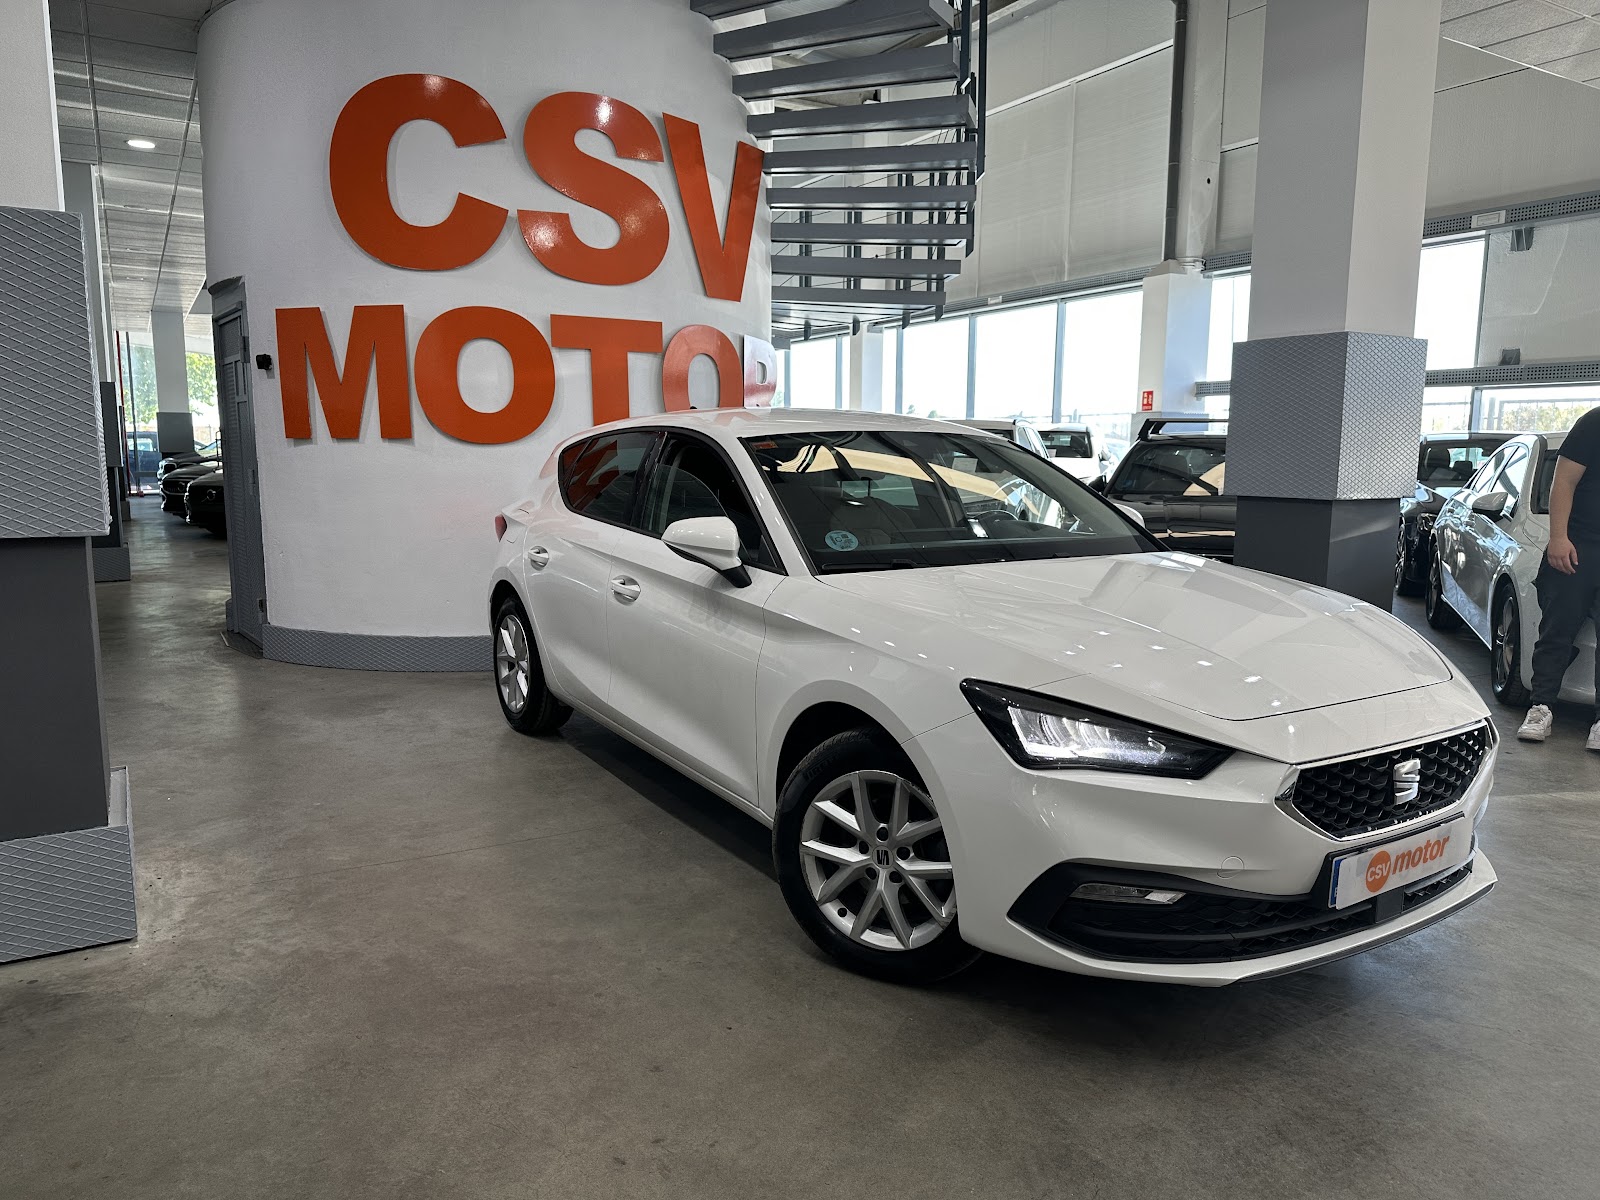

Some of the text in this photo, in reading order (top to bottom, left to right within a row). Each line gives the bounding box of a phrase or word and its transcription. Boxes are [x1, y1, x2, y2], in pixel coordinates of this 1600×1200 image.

[330, 74, 763, 302] CSV
[276, 305, 777, 444] MOTOR
[1392, 836, 1450, 875] motor
